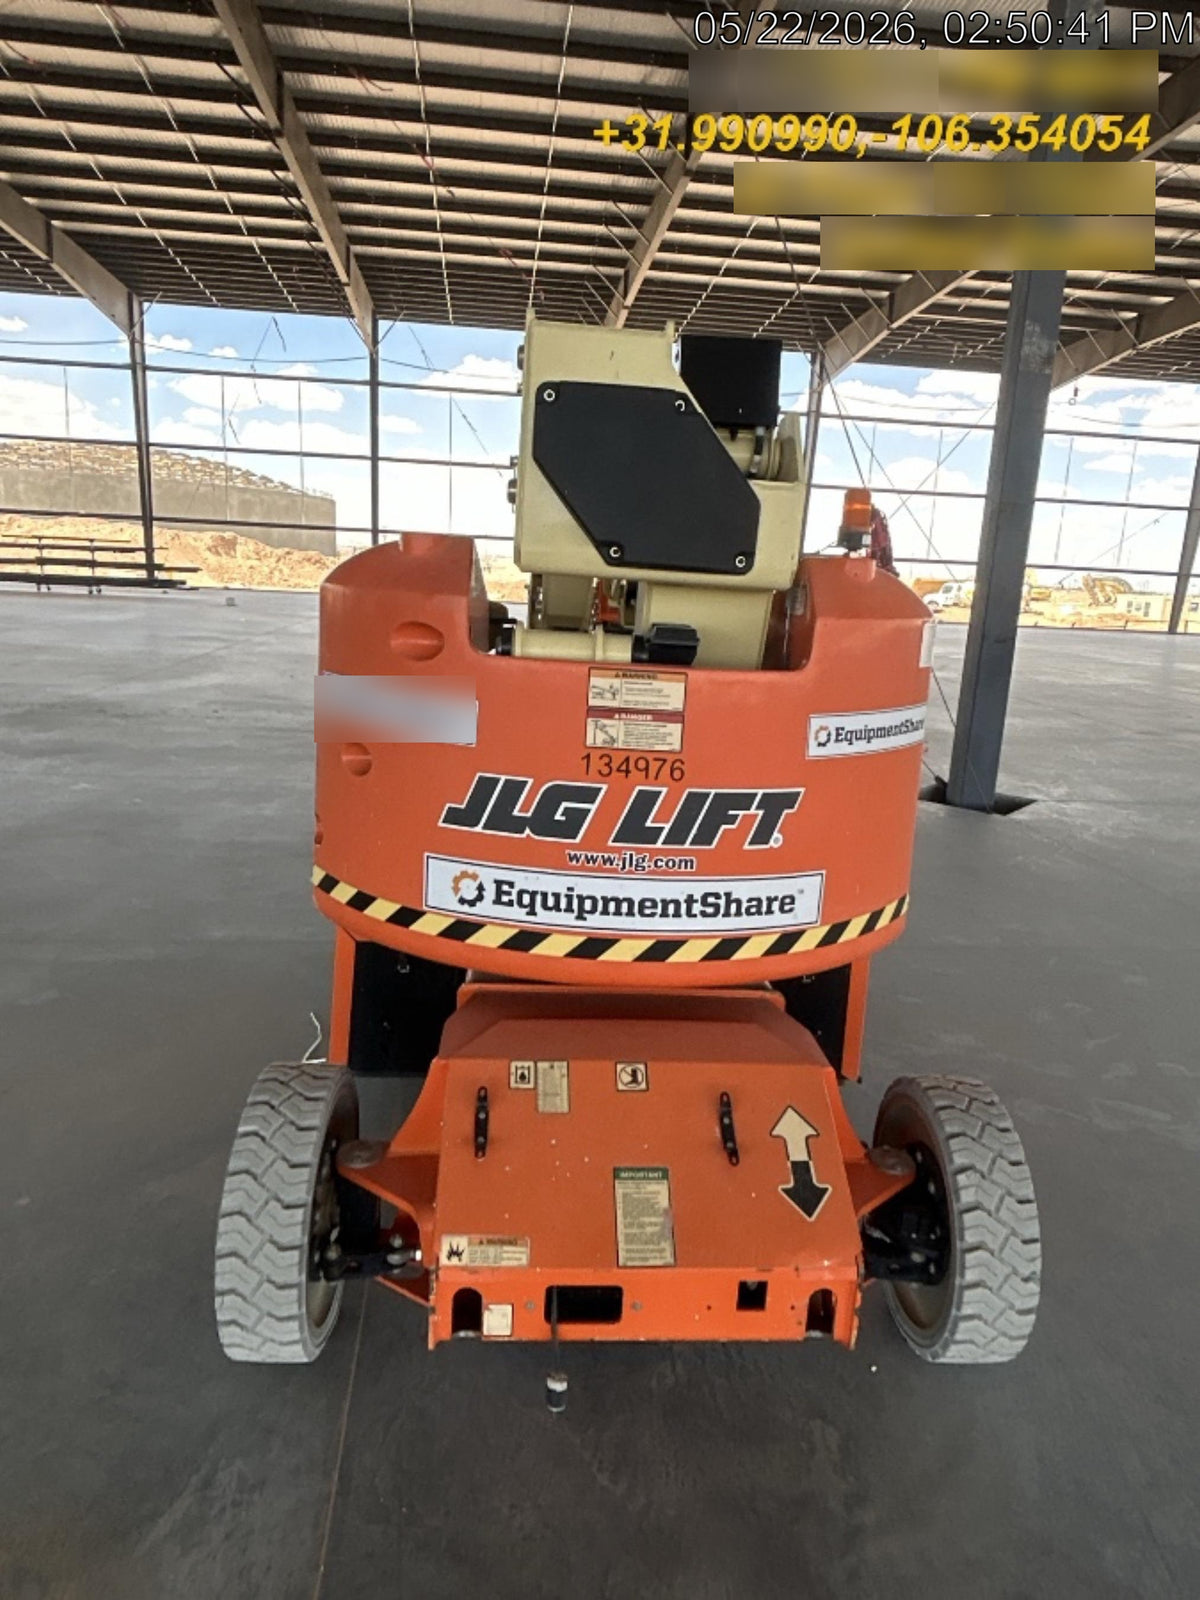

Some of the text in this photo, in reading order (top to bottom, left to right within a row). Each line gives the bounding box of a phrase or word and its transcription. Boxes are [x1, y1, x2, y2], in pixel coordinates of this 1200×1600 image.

[581, 752, 685, 782] 134976
[439, 773, 806, 849] JLG LIFT
[566, 850, 696, 873] www.jlg.com
[492, 879, 796, 922] EquipmentShare
